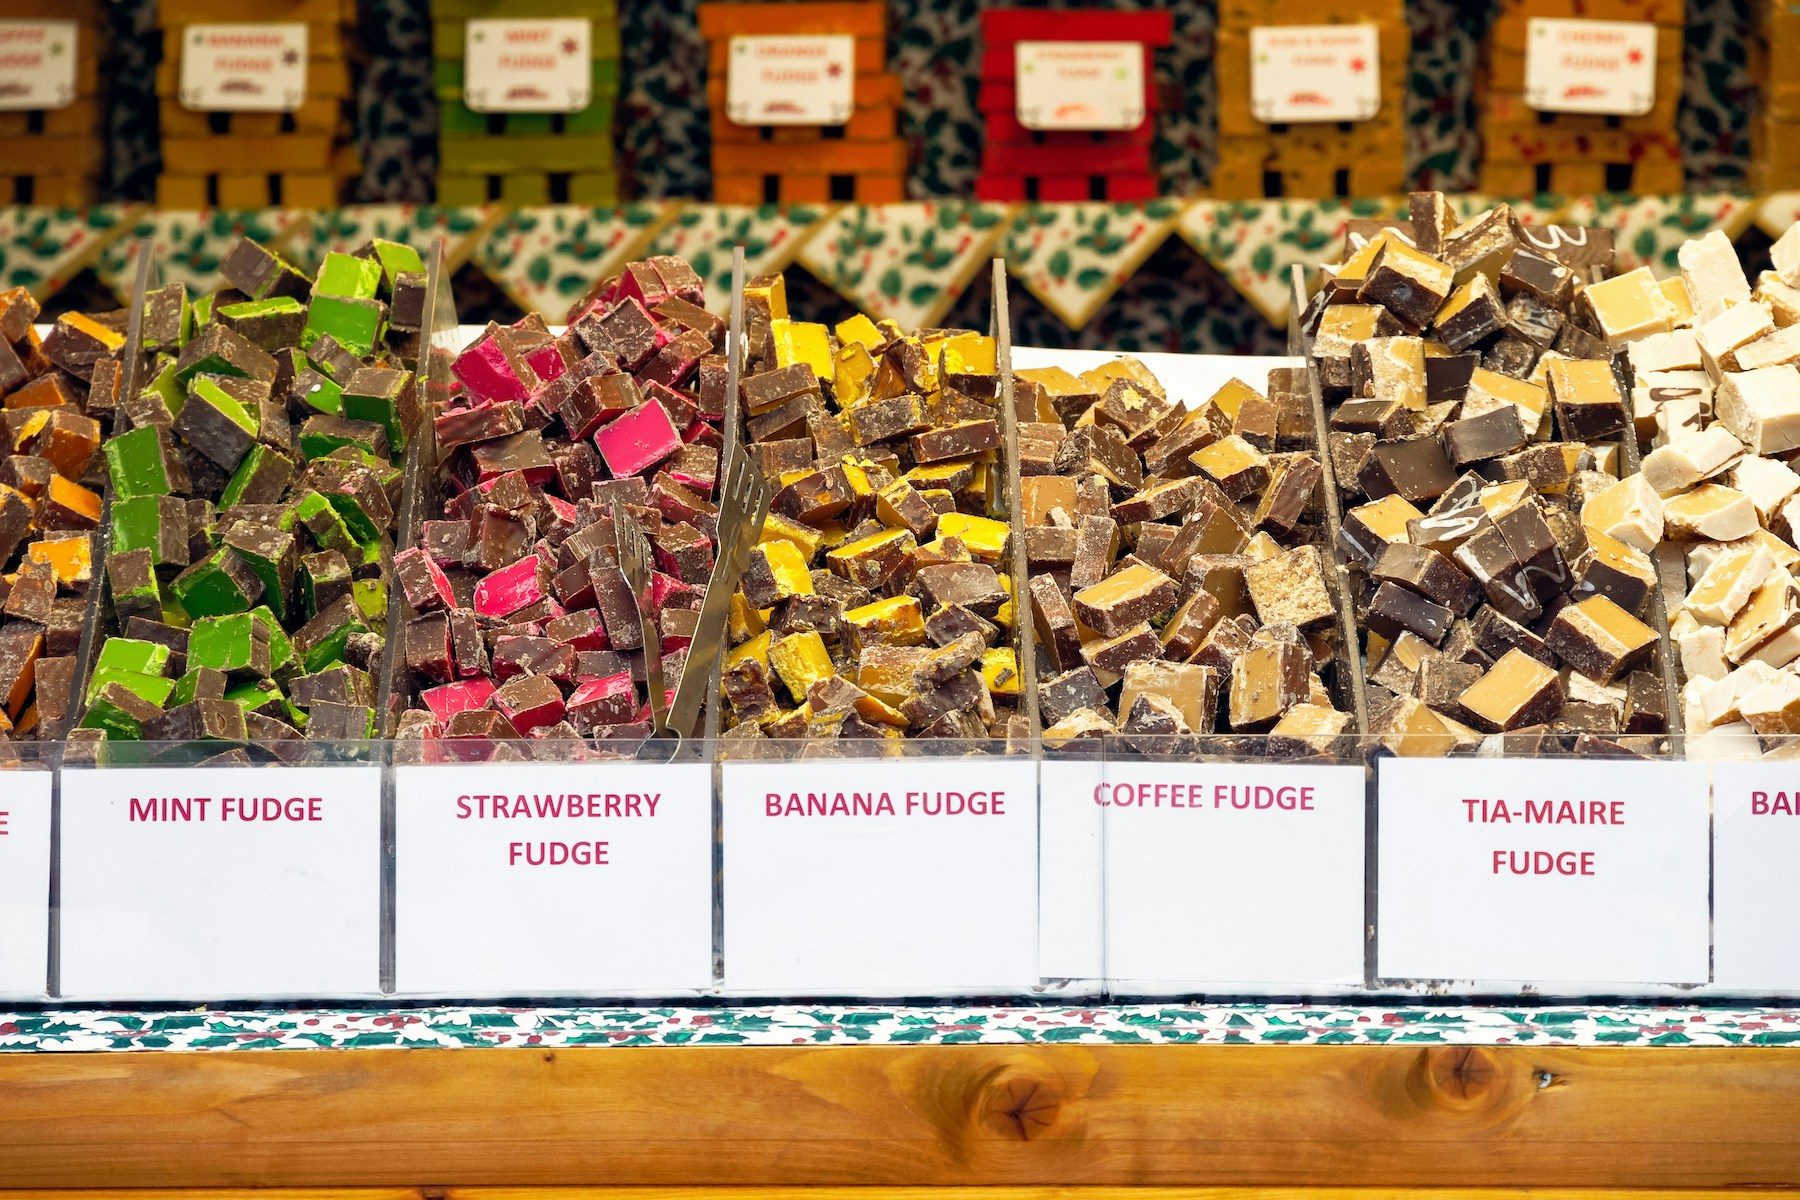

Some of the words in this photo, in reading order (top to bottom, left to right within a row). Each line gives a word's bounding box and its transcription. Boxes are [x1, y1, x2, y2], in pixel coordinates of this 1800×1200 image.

[456, 794, 661, 819] STRAWBERRY
[766, 792, 895, 816] BANANA
[906, 791, 1005, 816] FUDGE
[1094, 783, 1202, 808] COFFEE
[1214, 785, 1314, 810] FUDGE
[1752, 791, 1800, 816] BA
[130, 798, 211, 822] MINT
[222, 797, 322, 822] FUDGE
[1462, 799, 1625, 825] TIA-MAIRE
[509, 841, 608, 866] FUDGE
[1493, 850, 1594, 875] FUDGE
